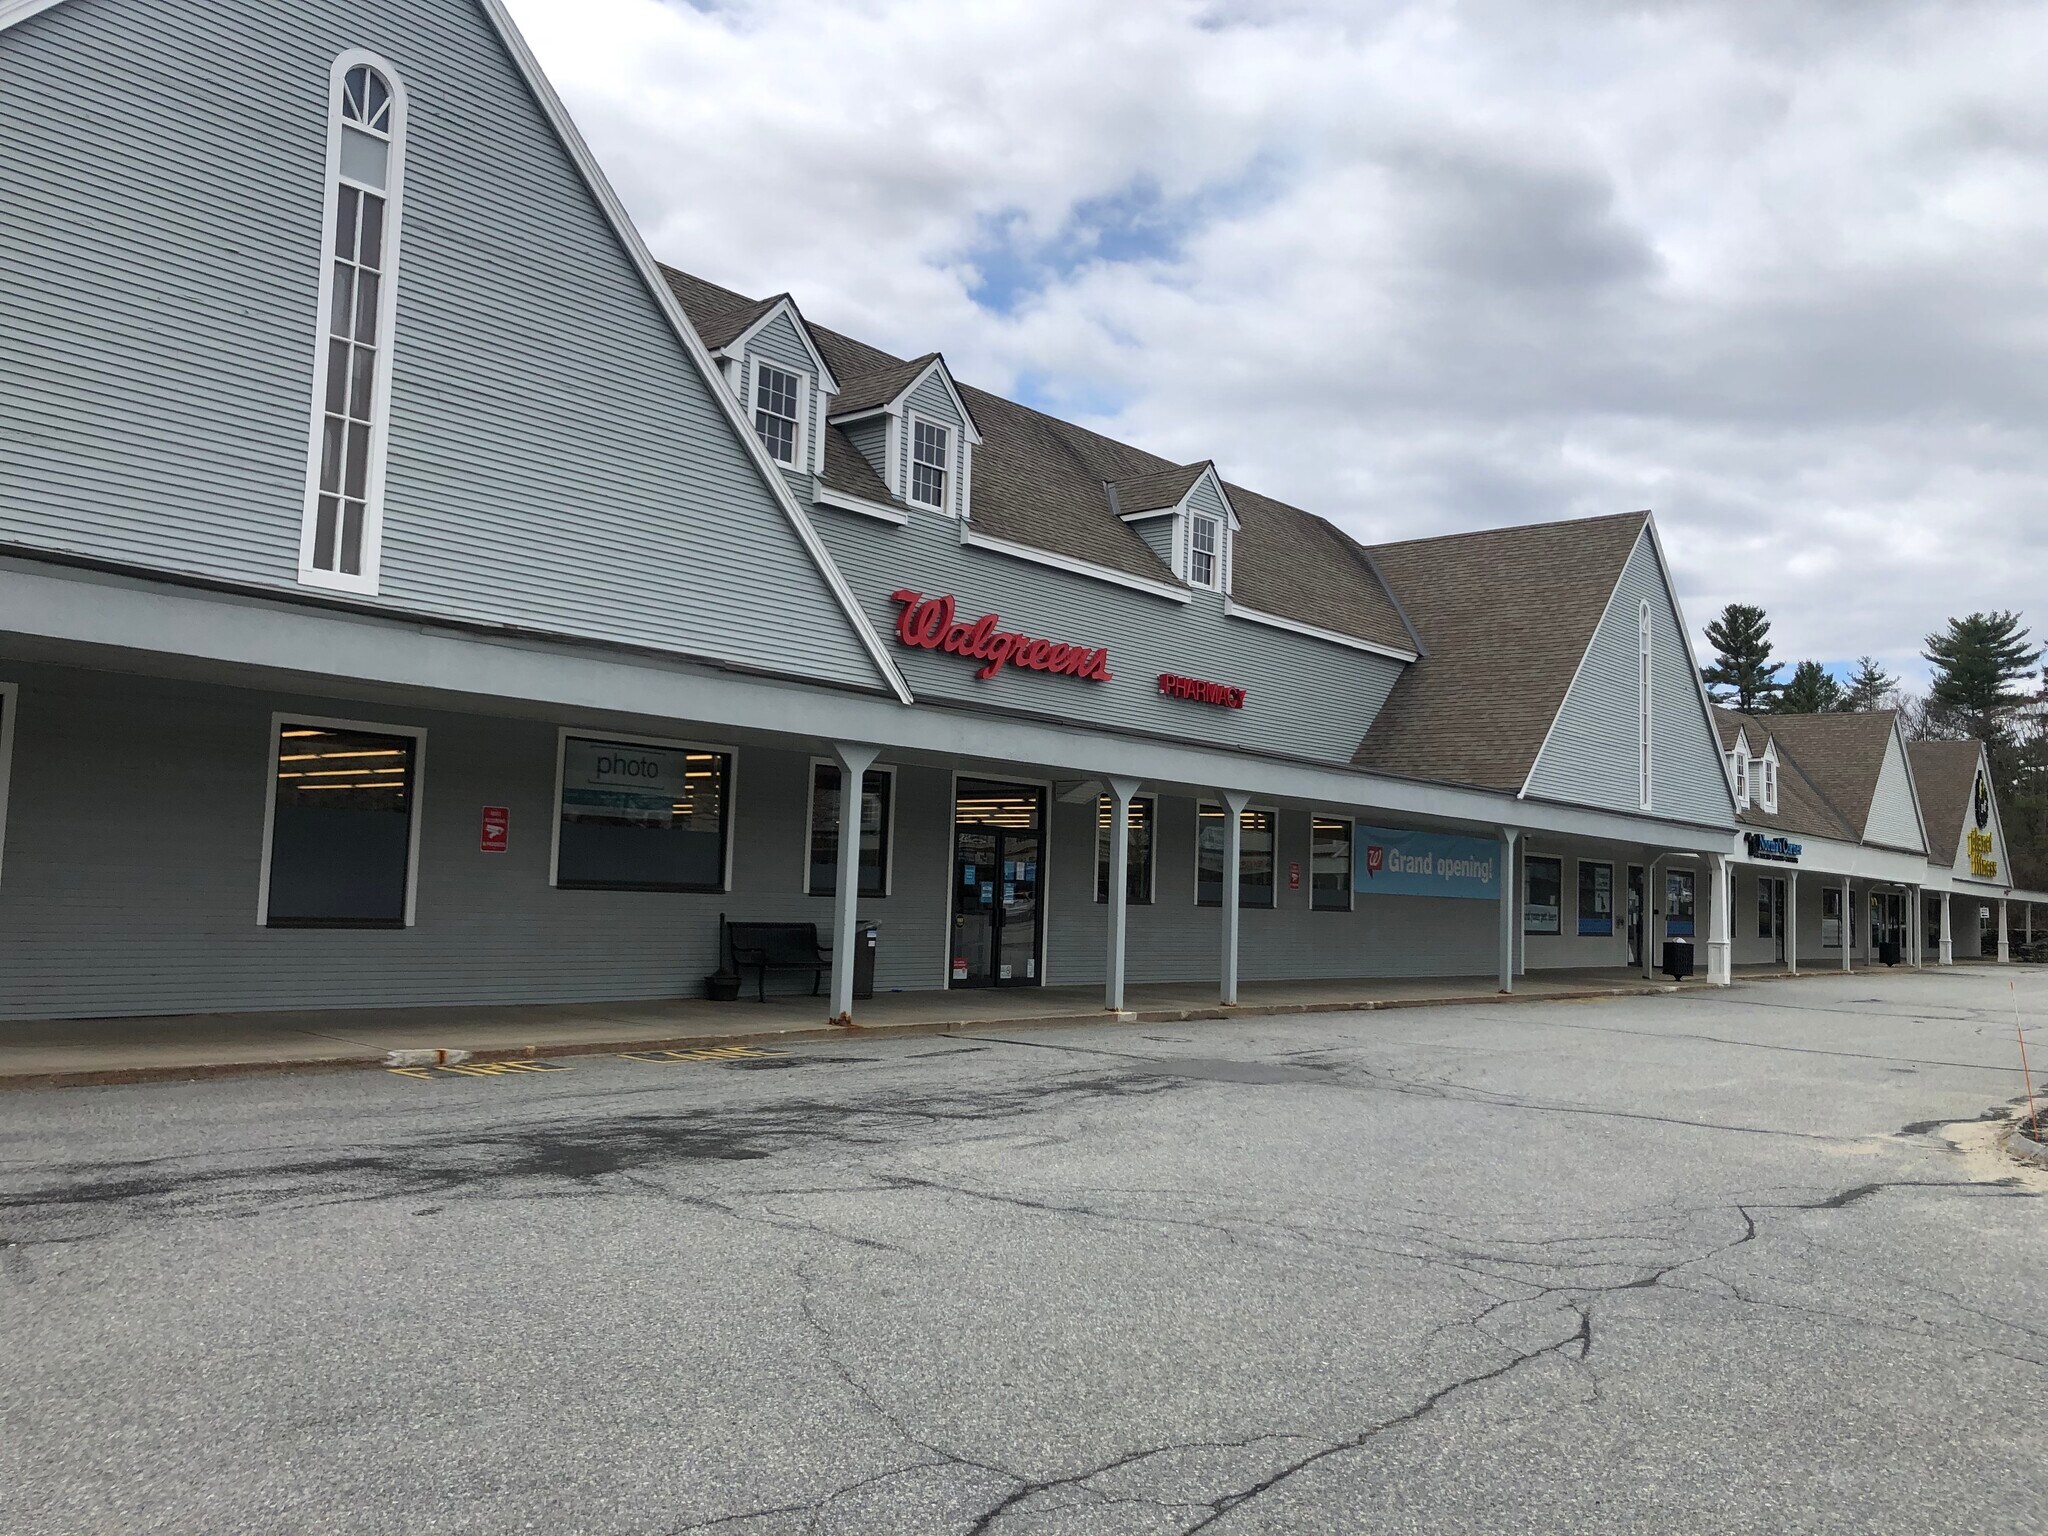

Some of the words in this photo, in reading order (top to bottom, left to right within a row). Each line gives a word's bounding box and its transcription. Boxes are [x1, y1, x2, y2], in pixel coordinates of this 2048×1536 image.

[890, 589, 1113, 681] Walgreens
[1160, 674, 1246, 709] PHARMACY
[597, 753, 659, 778] photo
[1389, 848, 1433, 875] Grand
[1437, 856, 1493, 883] opening!
